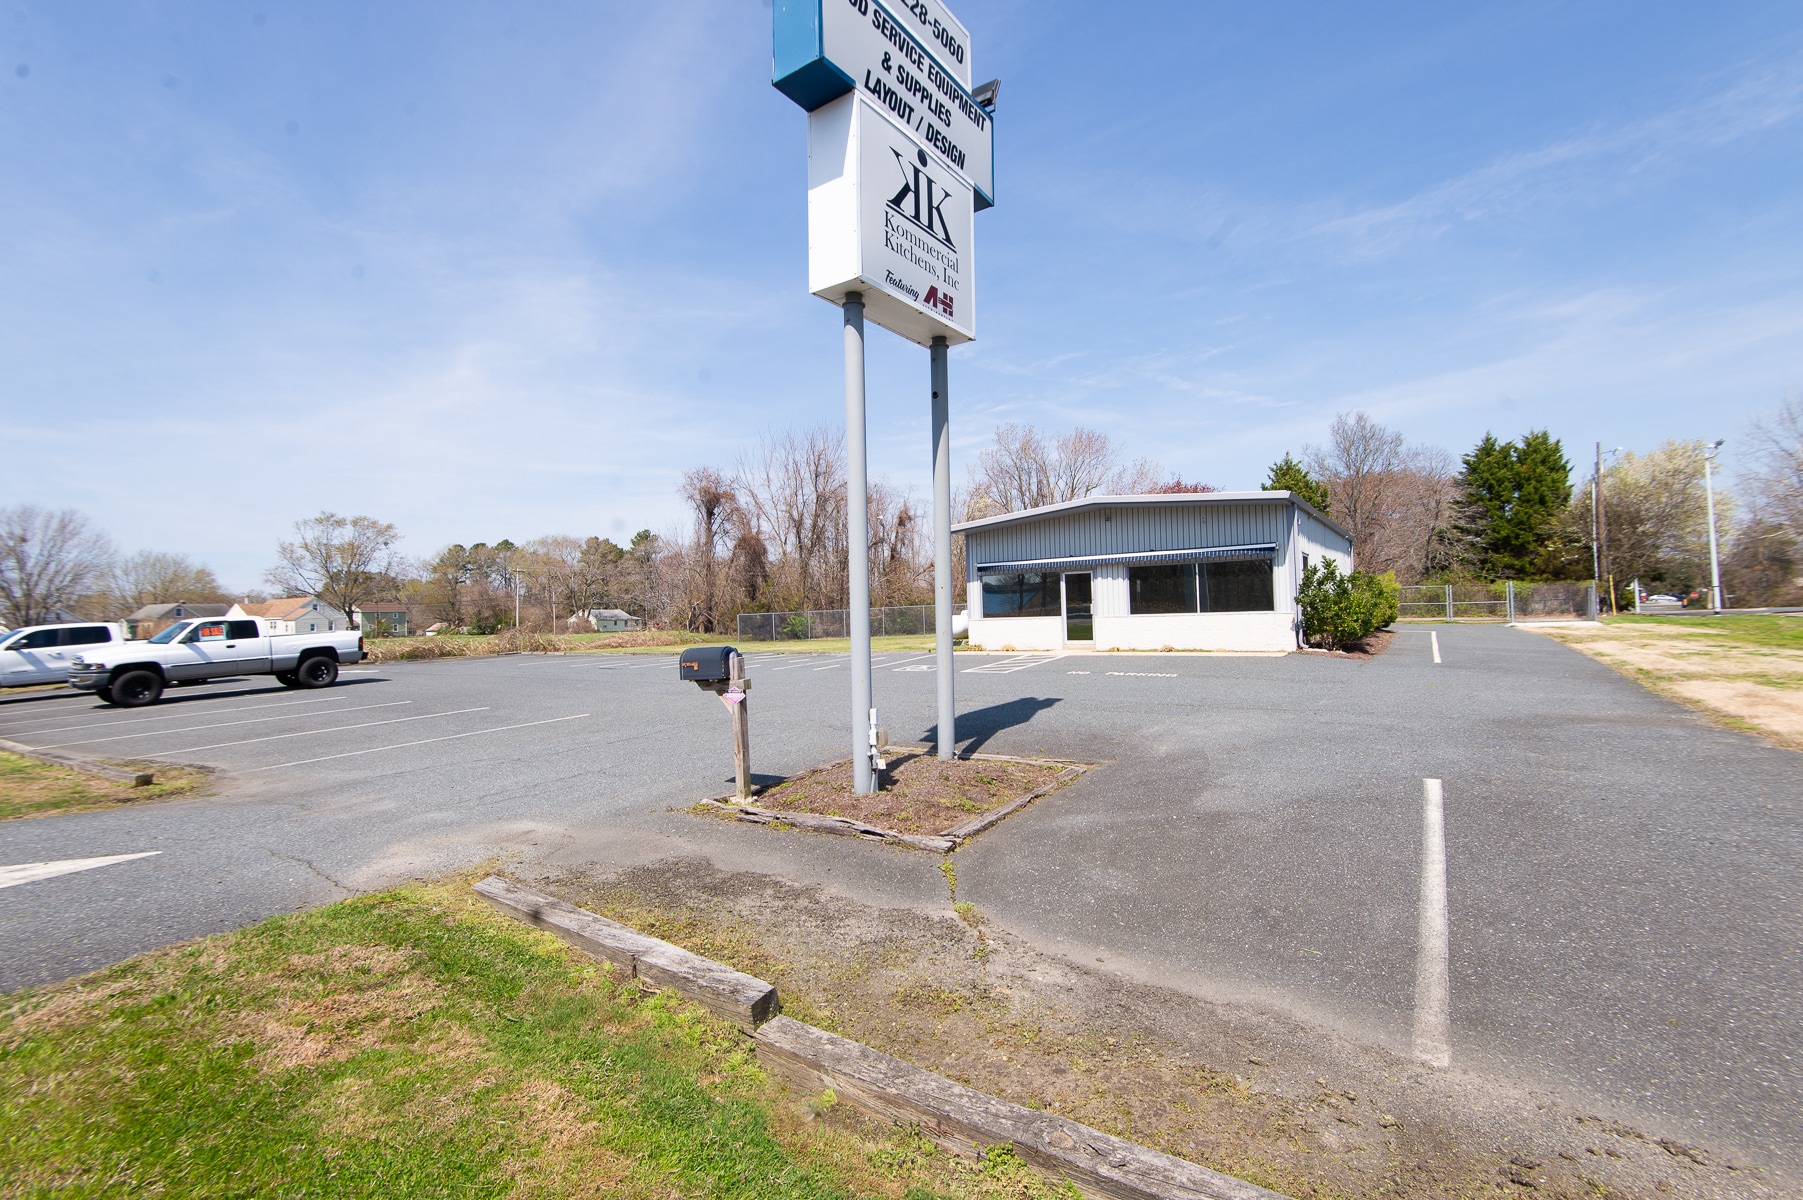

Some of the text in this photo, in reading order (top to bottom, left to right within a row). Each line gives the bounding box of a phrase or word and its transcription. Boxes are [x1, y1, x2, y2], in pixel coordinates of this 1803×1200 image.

[872, 8, 925, 74] SERVICE
[927, 62, 987, 132] EQUIPMENT
[881, 51, 952, 128] & SUPPLIES
[864, 68, 915, 126] LAYOUT
[925, 122, 966, 171] DESIGN
[884, 210, 959, 274] Kommercial
[884, 229, 960, 291] Kitchens, Inc
[885, 269, 920, 302] Featuring
